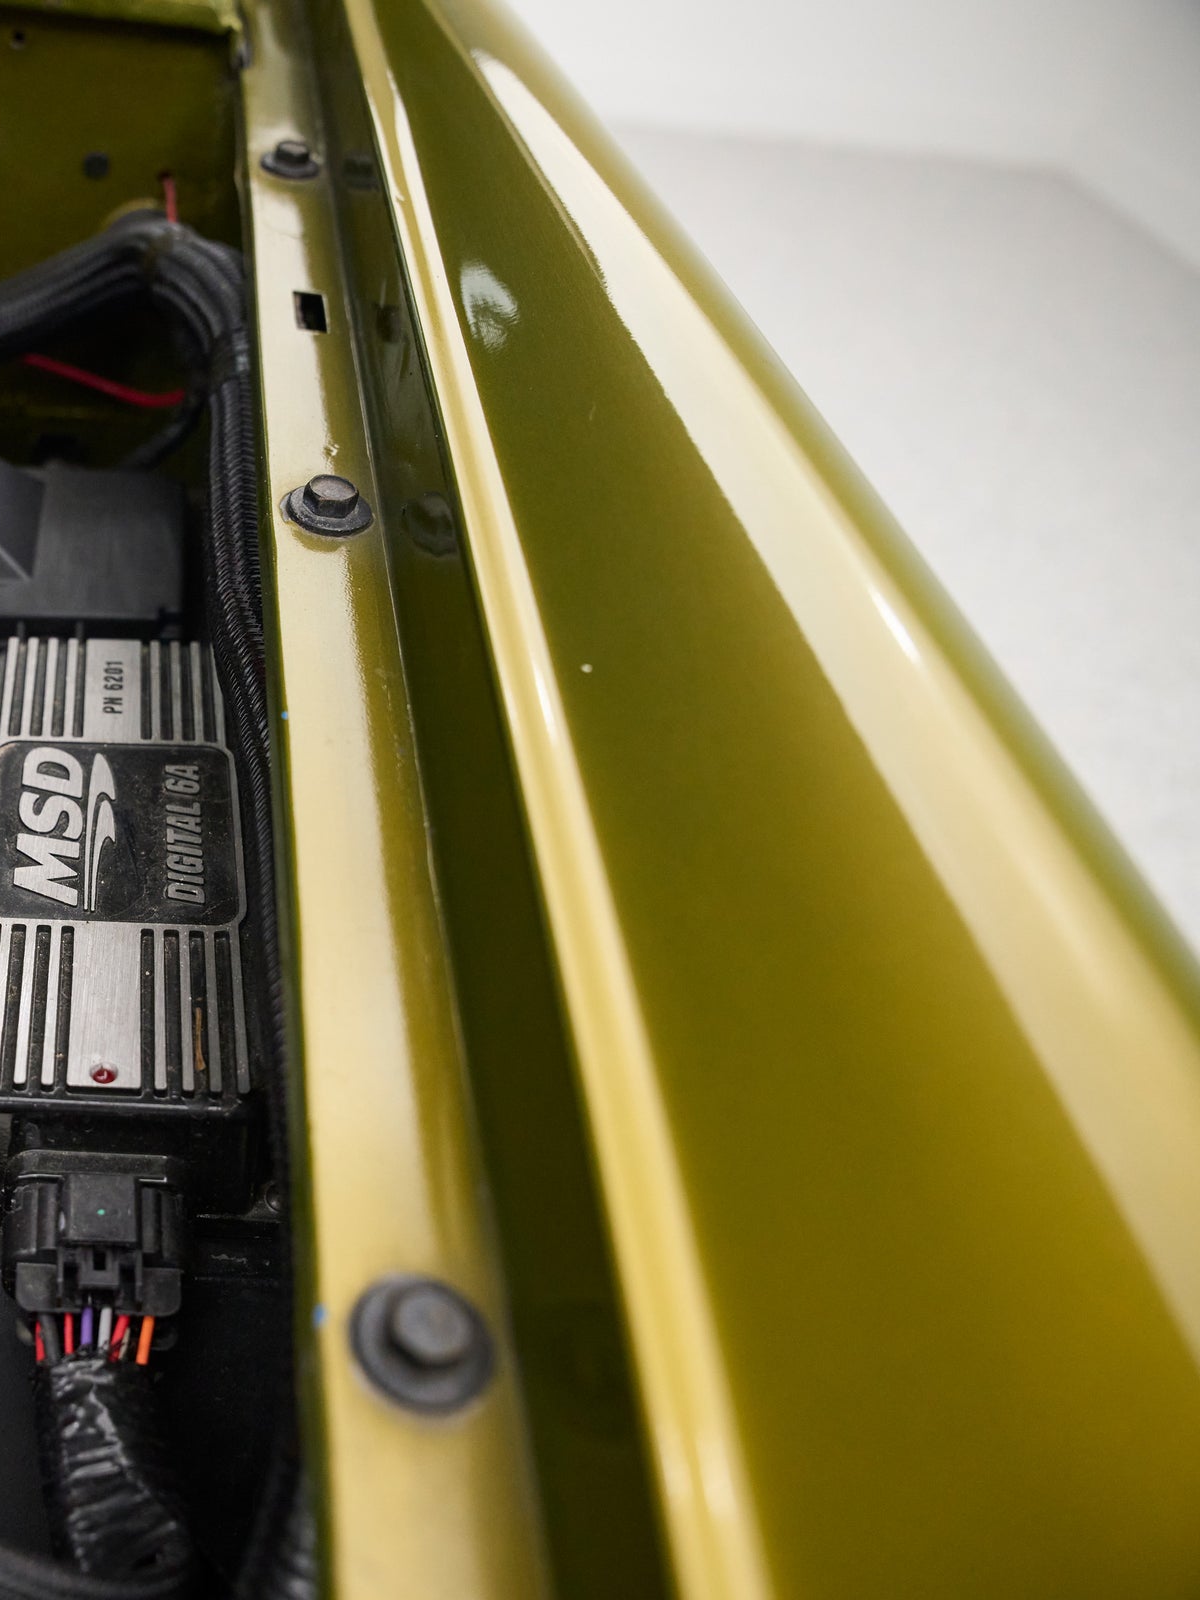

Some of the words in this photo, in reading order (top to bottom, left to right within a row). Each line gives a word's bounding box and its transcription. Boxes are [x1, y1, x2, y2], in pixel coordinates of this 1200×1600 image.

[103, 660, 123, 691] 6201
[103, 697, 123, 714] PN
[165, 764, 201, 795] 6A
[13, 746, 83, 906] MSD
[166, 803, 205, 904] DIGITAL
